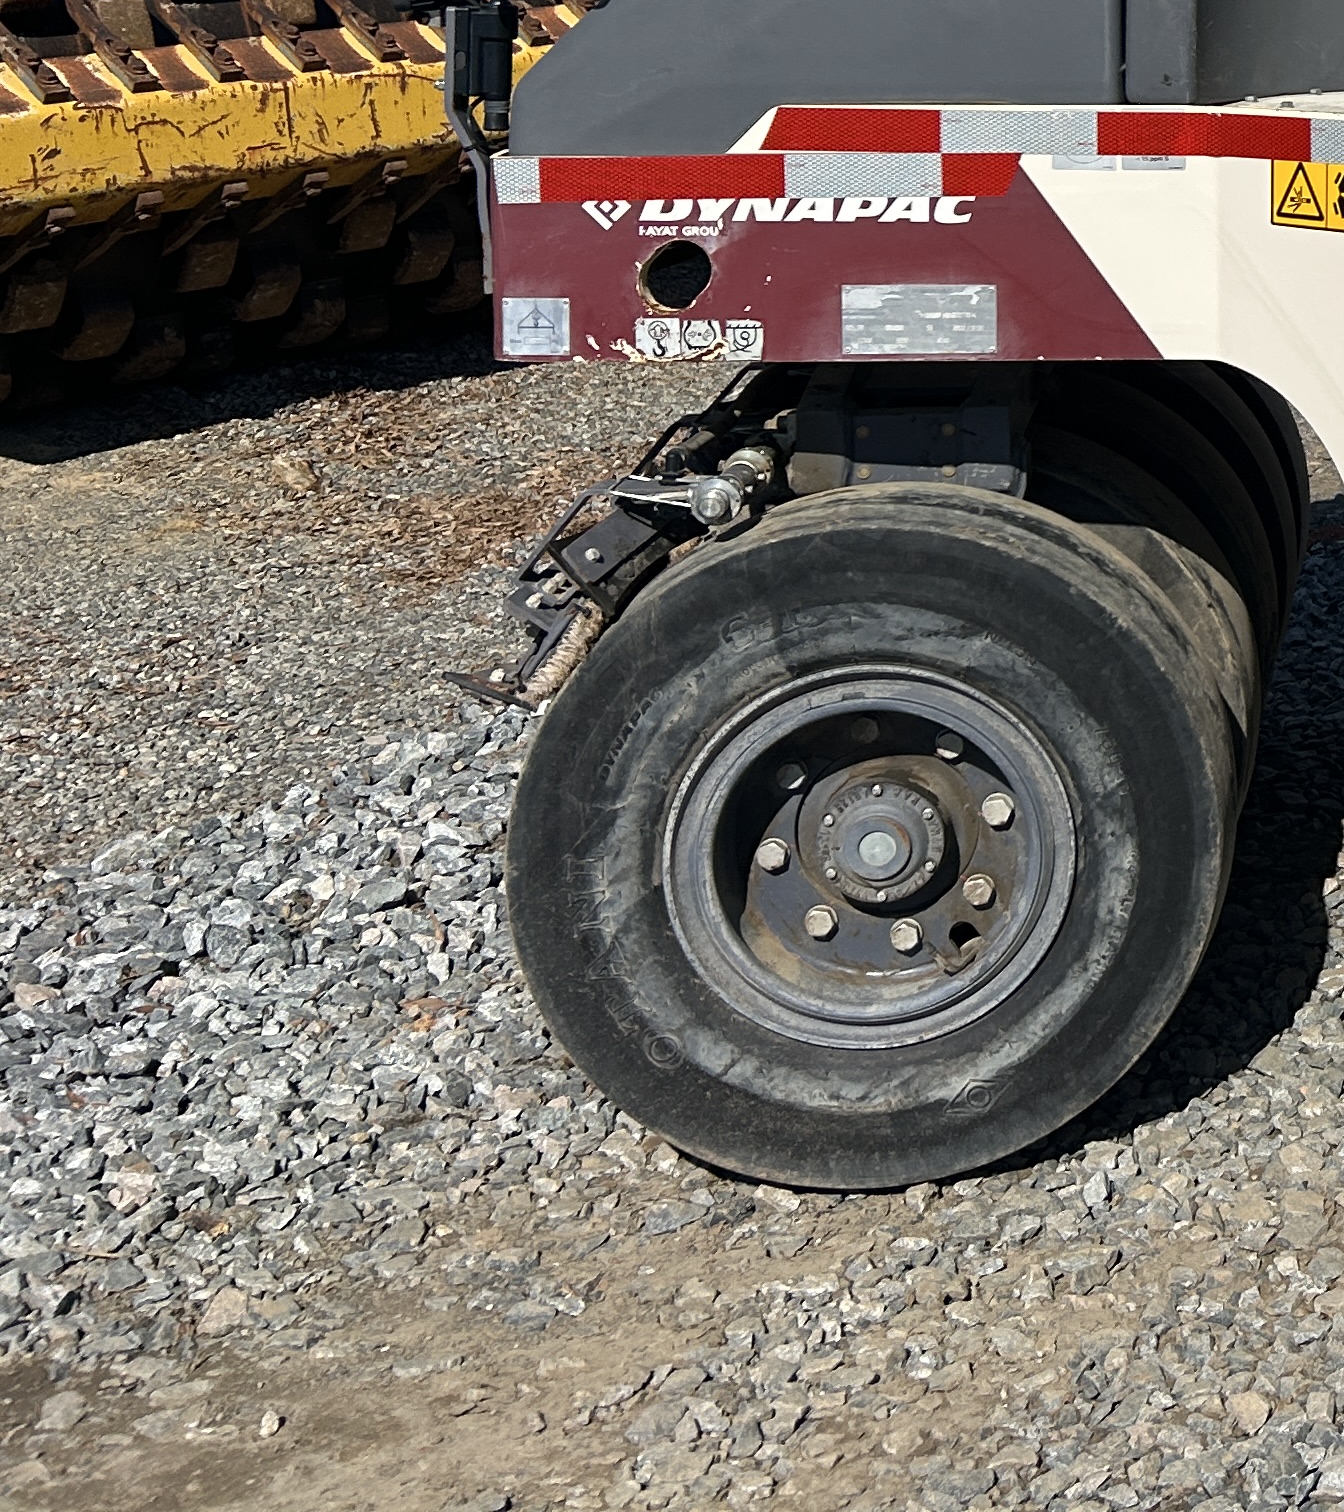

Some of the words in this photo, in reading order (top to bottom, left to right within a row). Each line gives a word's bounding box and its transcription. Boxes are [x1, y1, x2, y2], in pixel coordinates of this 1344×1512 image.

[638, 196, 977, 225] DYNAPAC
[681, 225, 722, 237] GROU
[562, 851, 687, 1070] OTANI
